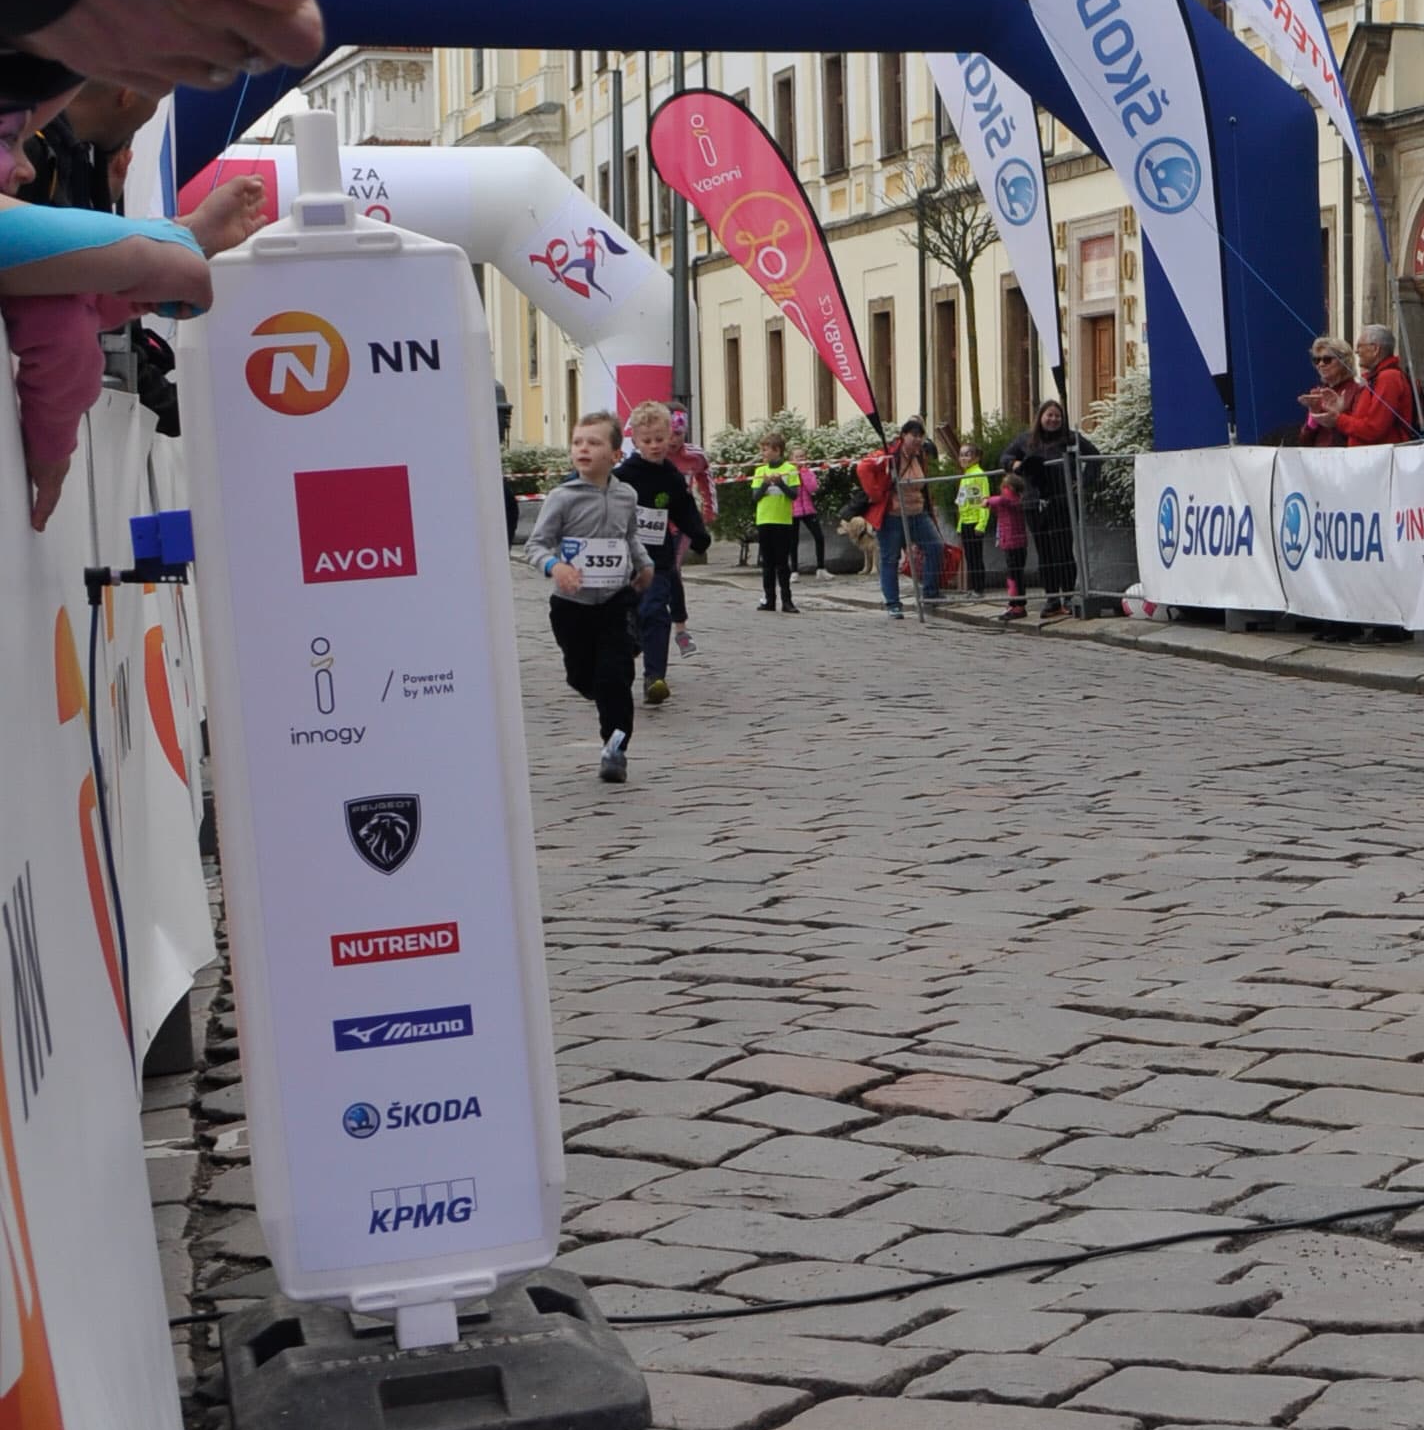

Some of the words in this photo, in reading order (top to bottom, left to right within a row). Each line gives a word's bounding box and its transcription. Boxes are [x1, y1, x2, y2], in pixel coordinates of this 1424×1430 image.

[347, 181, 389, 200] AVÁ
[368, 338, 441, 374] NN
[1182, 495, 1254, 557] ŠKODA
[1314, 502, 1385, 563] ŠKODA
[314, 547, 403, 574] AVON
[585, 555, 623, 568] 3357
[402, 670, 454, 684] Powered
[403, 686, 418, 699] by
[423, 683, 454, 696] MVM
[291, 726, 366, 745] innogy
[351, 800, 413, 814] PEUGEOT
[338, 929, 454, 959] NUTREND
[386, 1096, 482, 1131] ŠKODA
[369, 1197, 473, 1234] KPMG
